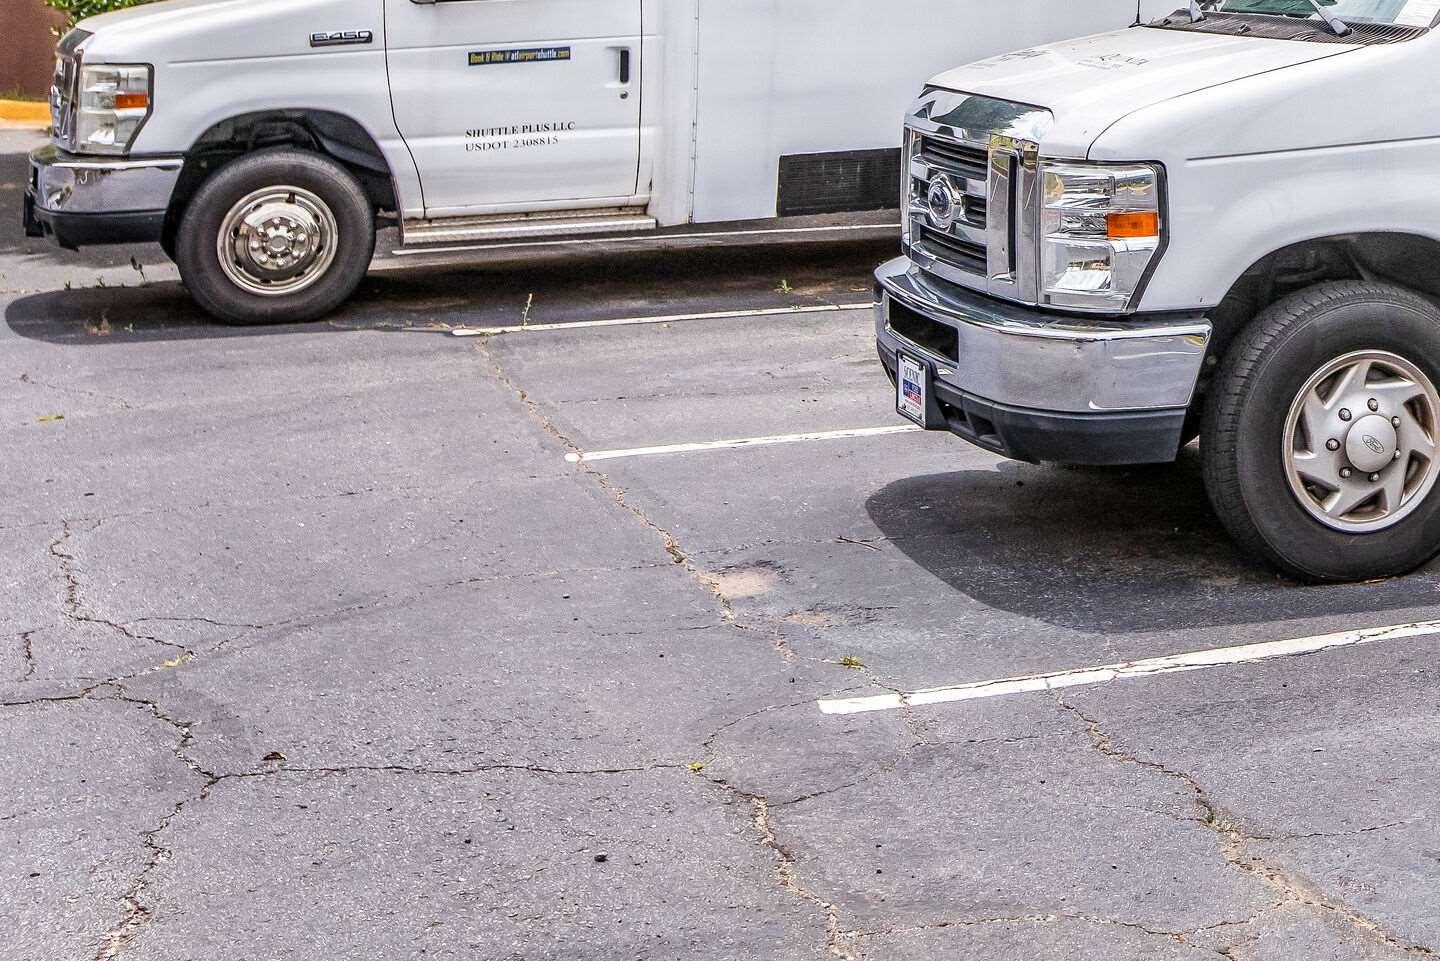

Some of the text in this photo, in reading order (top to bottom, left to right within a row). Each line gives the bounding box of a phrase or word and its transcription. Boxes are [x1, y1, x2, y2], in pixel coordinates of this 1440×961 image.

[464, 120, 577, 138] SHUTTLE PLUS LLC
[464, 140, 510, 152] USDOT
